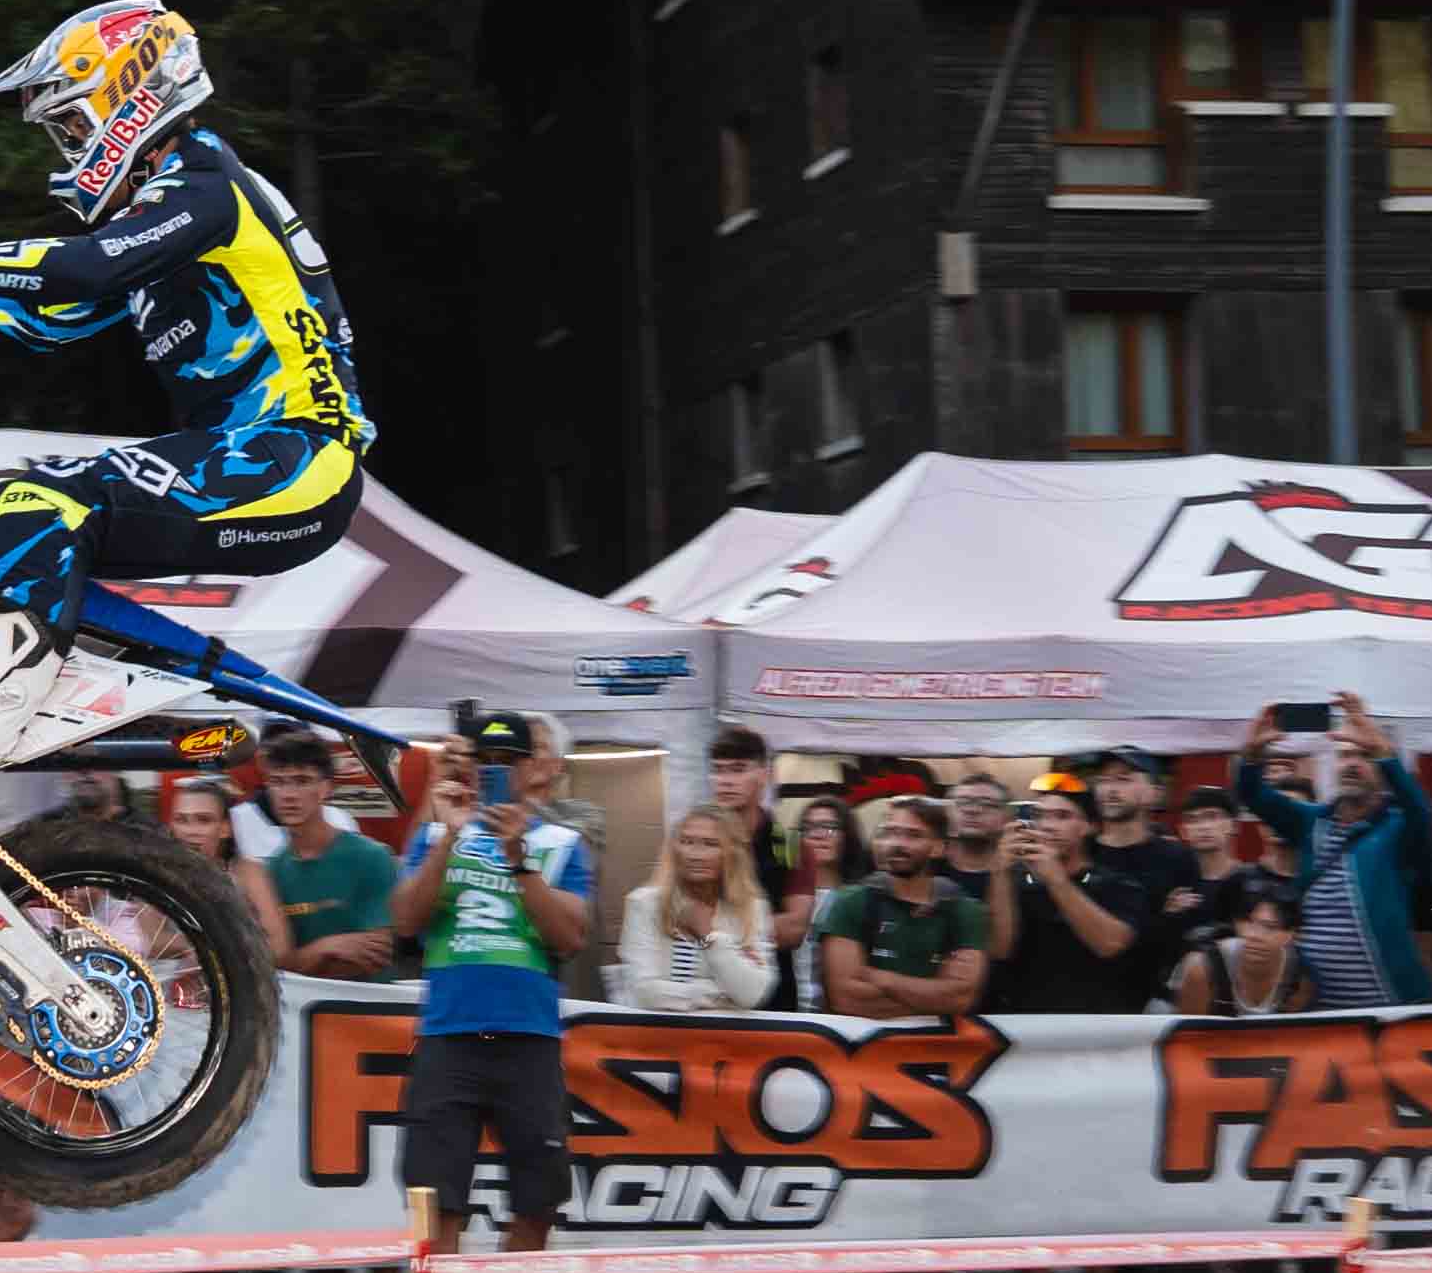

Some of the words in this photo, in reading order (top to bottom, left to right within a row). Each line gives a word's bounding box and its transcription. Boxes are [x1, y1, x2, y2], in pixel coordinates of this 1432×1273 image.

[77, 136, 125, 196] Red
[110, 87, 165, 148] Bull
[122, 212, 194, 250] Husqvarna
[237, 521, 322, 544] Husqvarna
[455, 889, 516, 930] 2
